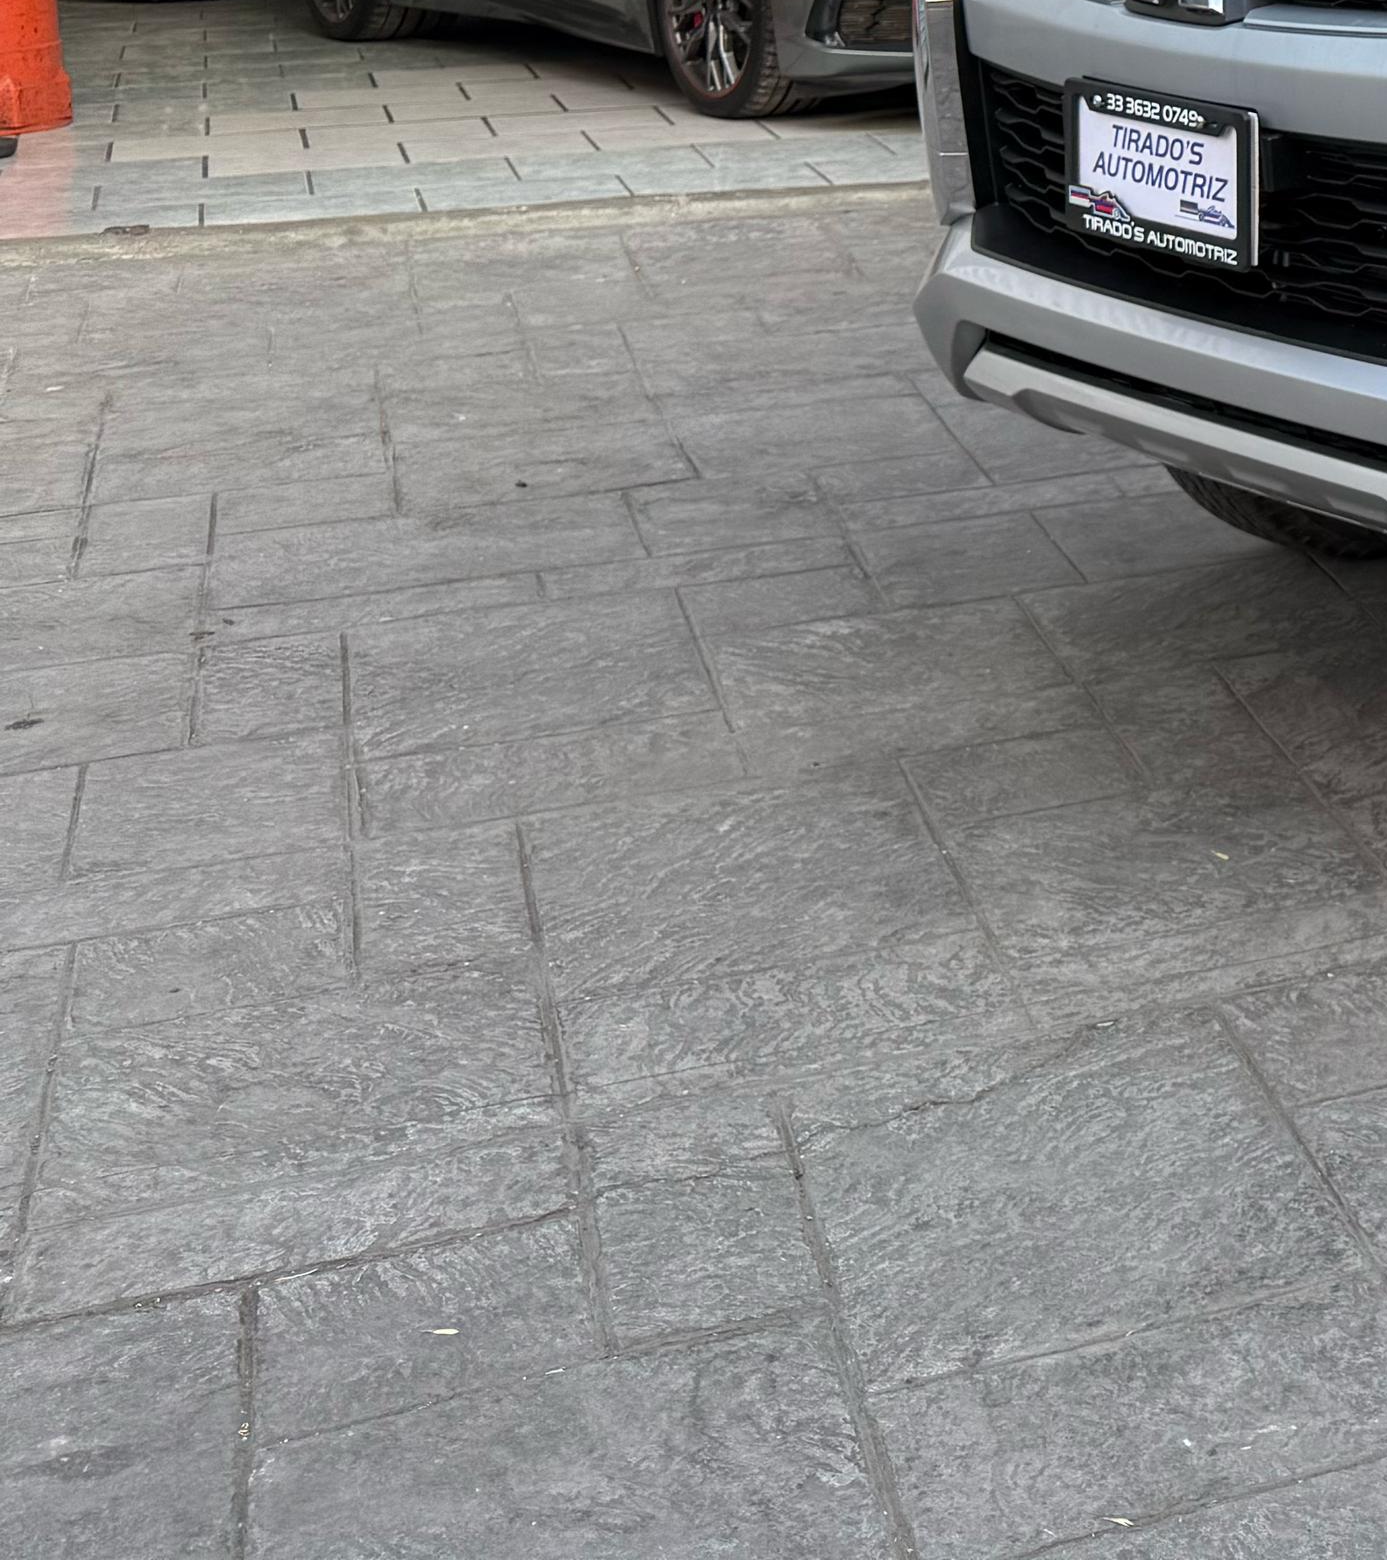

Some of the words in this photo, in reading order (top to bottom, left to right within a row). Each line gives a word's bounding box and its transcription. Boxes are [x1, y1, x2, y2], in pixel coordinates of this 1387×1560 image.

[1106, 93, 1124, 112] 33
[1125, 97, 1160, 120] 3632
[1162, 104, 1199, 128] 0749
[1112, 124, 1204, 166] TIRADO'S
[1092, 151, 1229, 203] AUTOMOTRIZ
[1082, 214, 1145, 243] TIRADO'S
[1146, 231, 1238, 265] AUTOMOTRIZ
